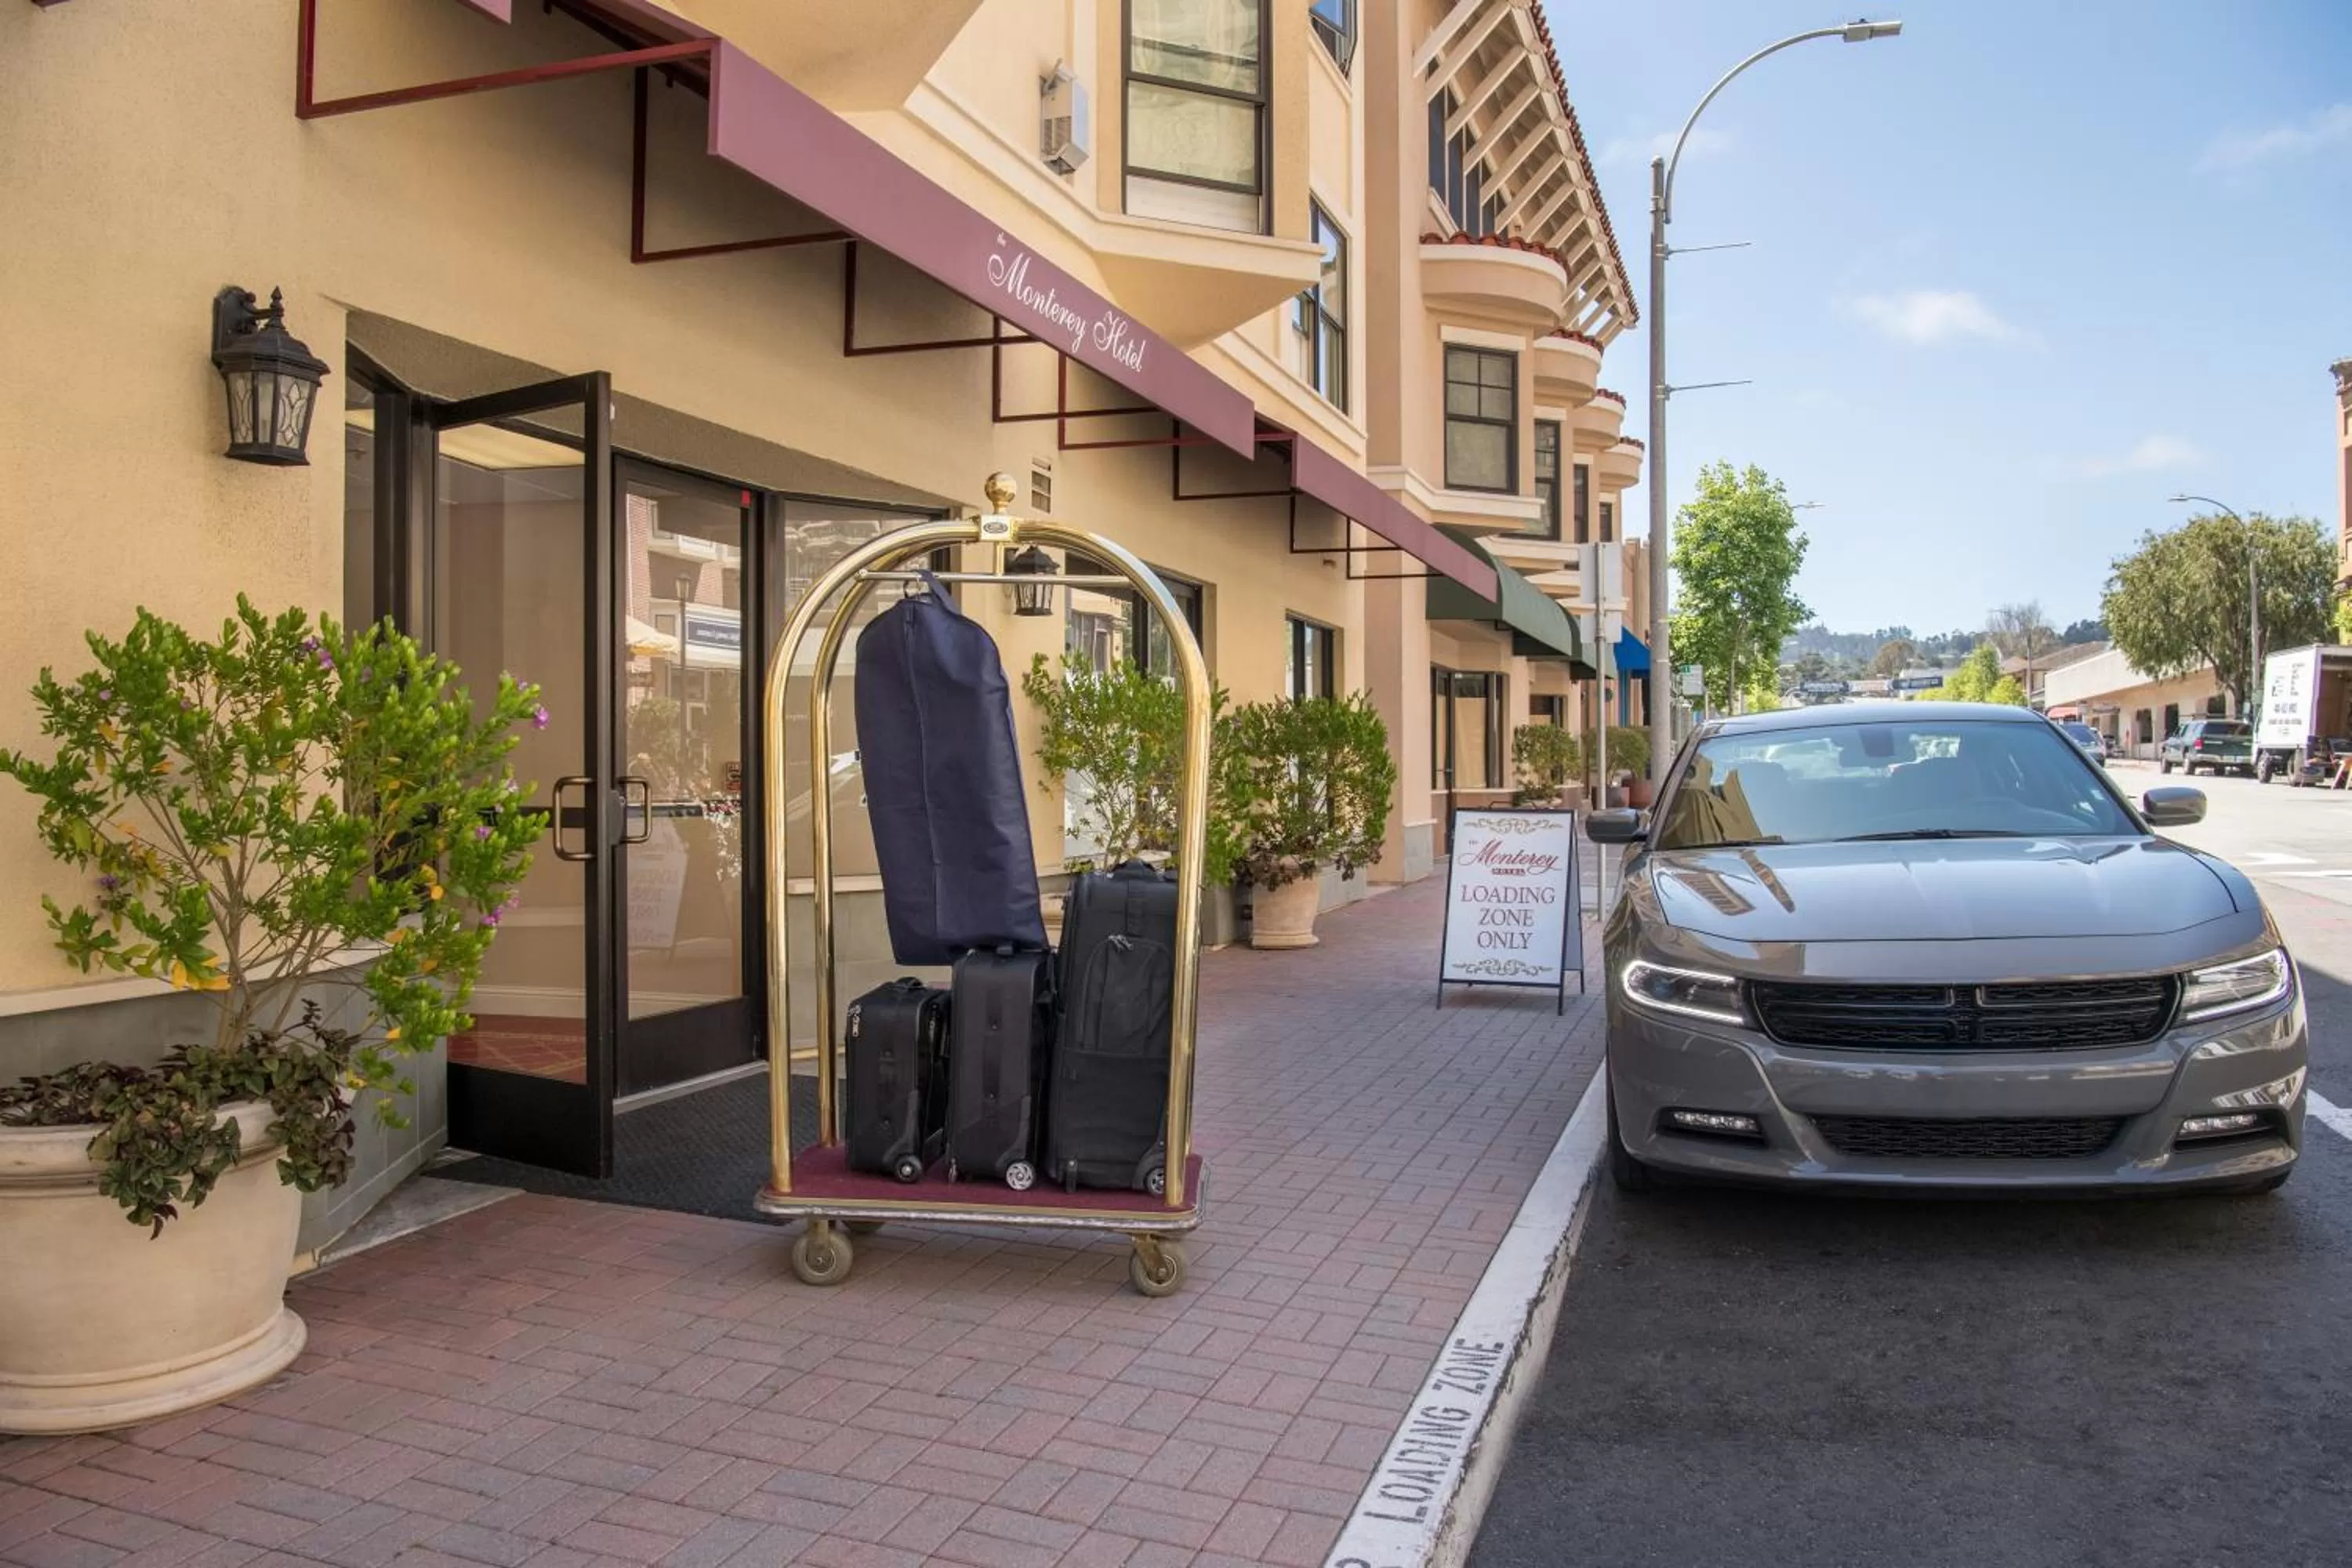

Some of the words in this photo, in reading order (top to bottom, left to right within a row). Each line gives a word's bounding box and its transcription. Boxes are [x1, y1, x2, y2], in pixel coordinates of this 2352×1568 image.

[988, 252, 1086, 353] Monterey
[1093, 310, 1146, 372] Hotel
[1457, 838, 1563, 875] Monterey
[1461, 884, 1555, 904] LOADING
[1479, 908, 1534, 927] ZONE
[1477, 931, 1532, 949] ONLY
[1363, 1406, 1472, 1523] LOADING
[1432, 1338, 1504, 1396] ZONE
